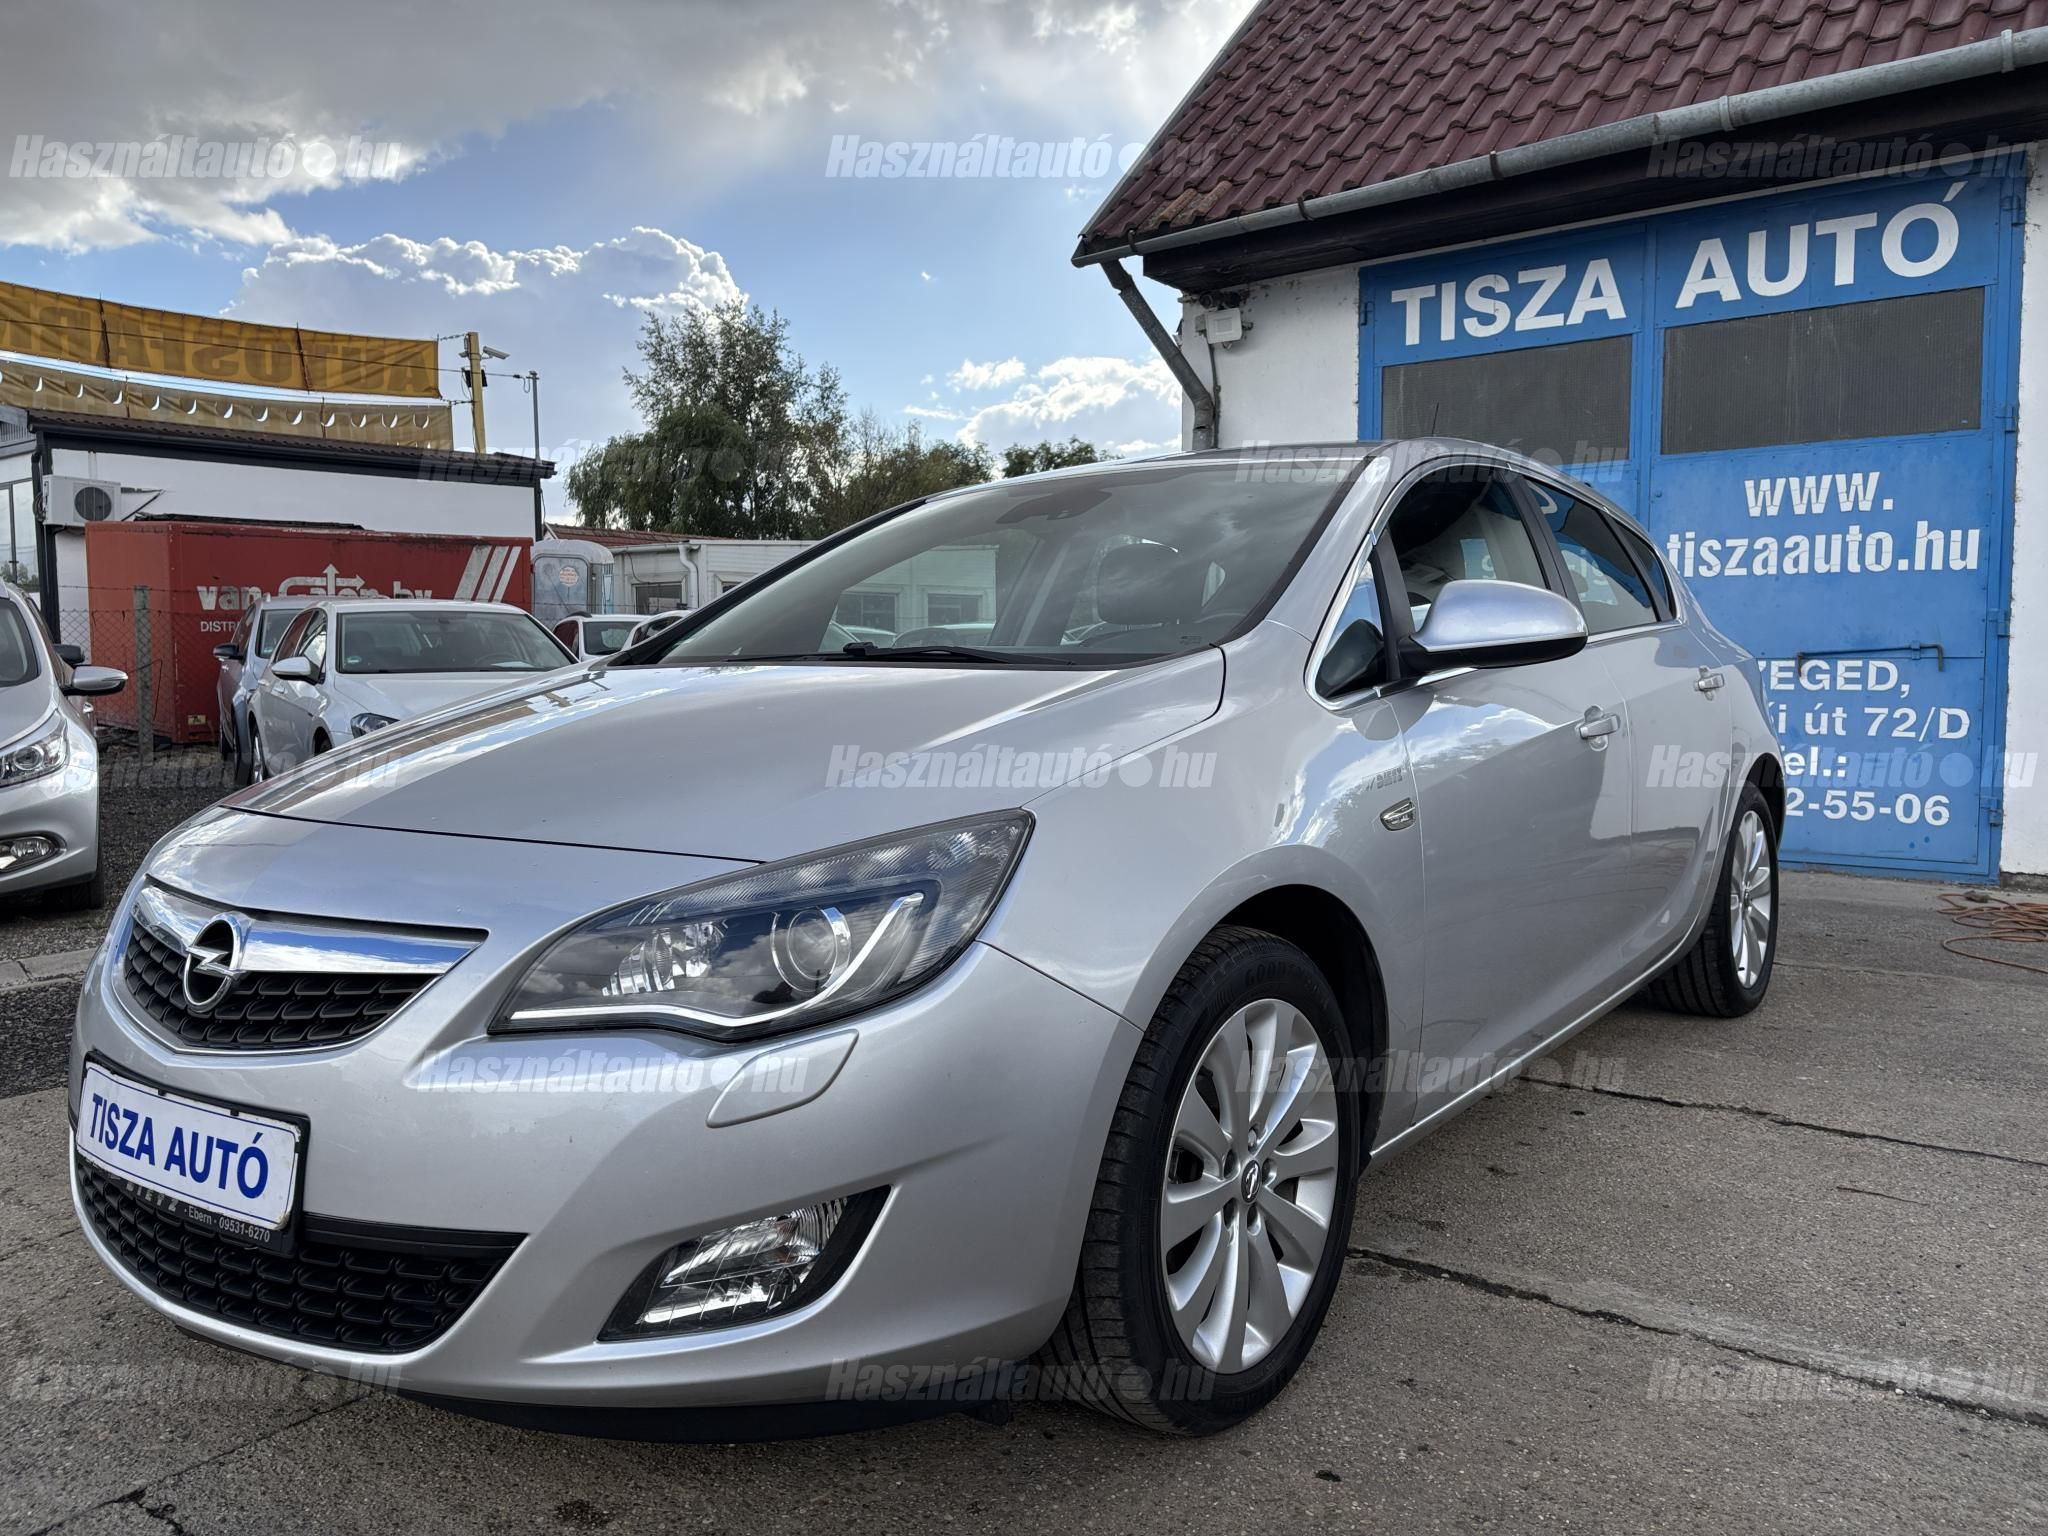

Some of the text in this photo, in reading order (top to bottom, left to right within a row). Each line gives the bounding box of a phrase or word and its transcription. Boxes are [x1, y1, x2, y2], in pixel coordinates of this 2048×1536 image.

[1391, 181, 1968, 346] TISZA AUTÓ
[1743, 471, 1895, 517] www.
[1666, 520, 1981, 578] tiszaauto.hu
[196, 585, 263, 610] van
[1758, 659, 1911, 698] EGED,
[1804, 702, 1848, 736] út
[1863, 706, 1971, 742] 72/D
[1780, 745, 1847, 777] el.:
[89, 1092, 269, 1199] TISZA AUTÓ
[188, 1205, 213, 1225] Ebern
[218, 1216, 271, 1243] 09531-6270
